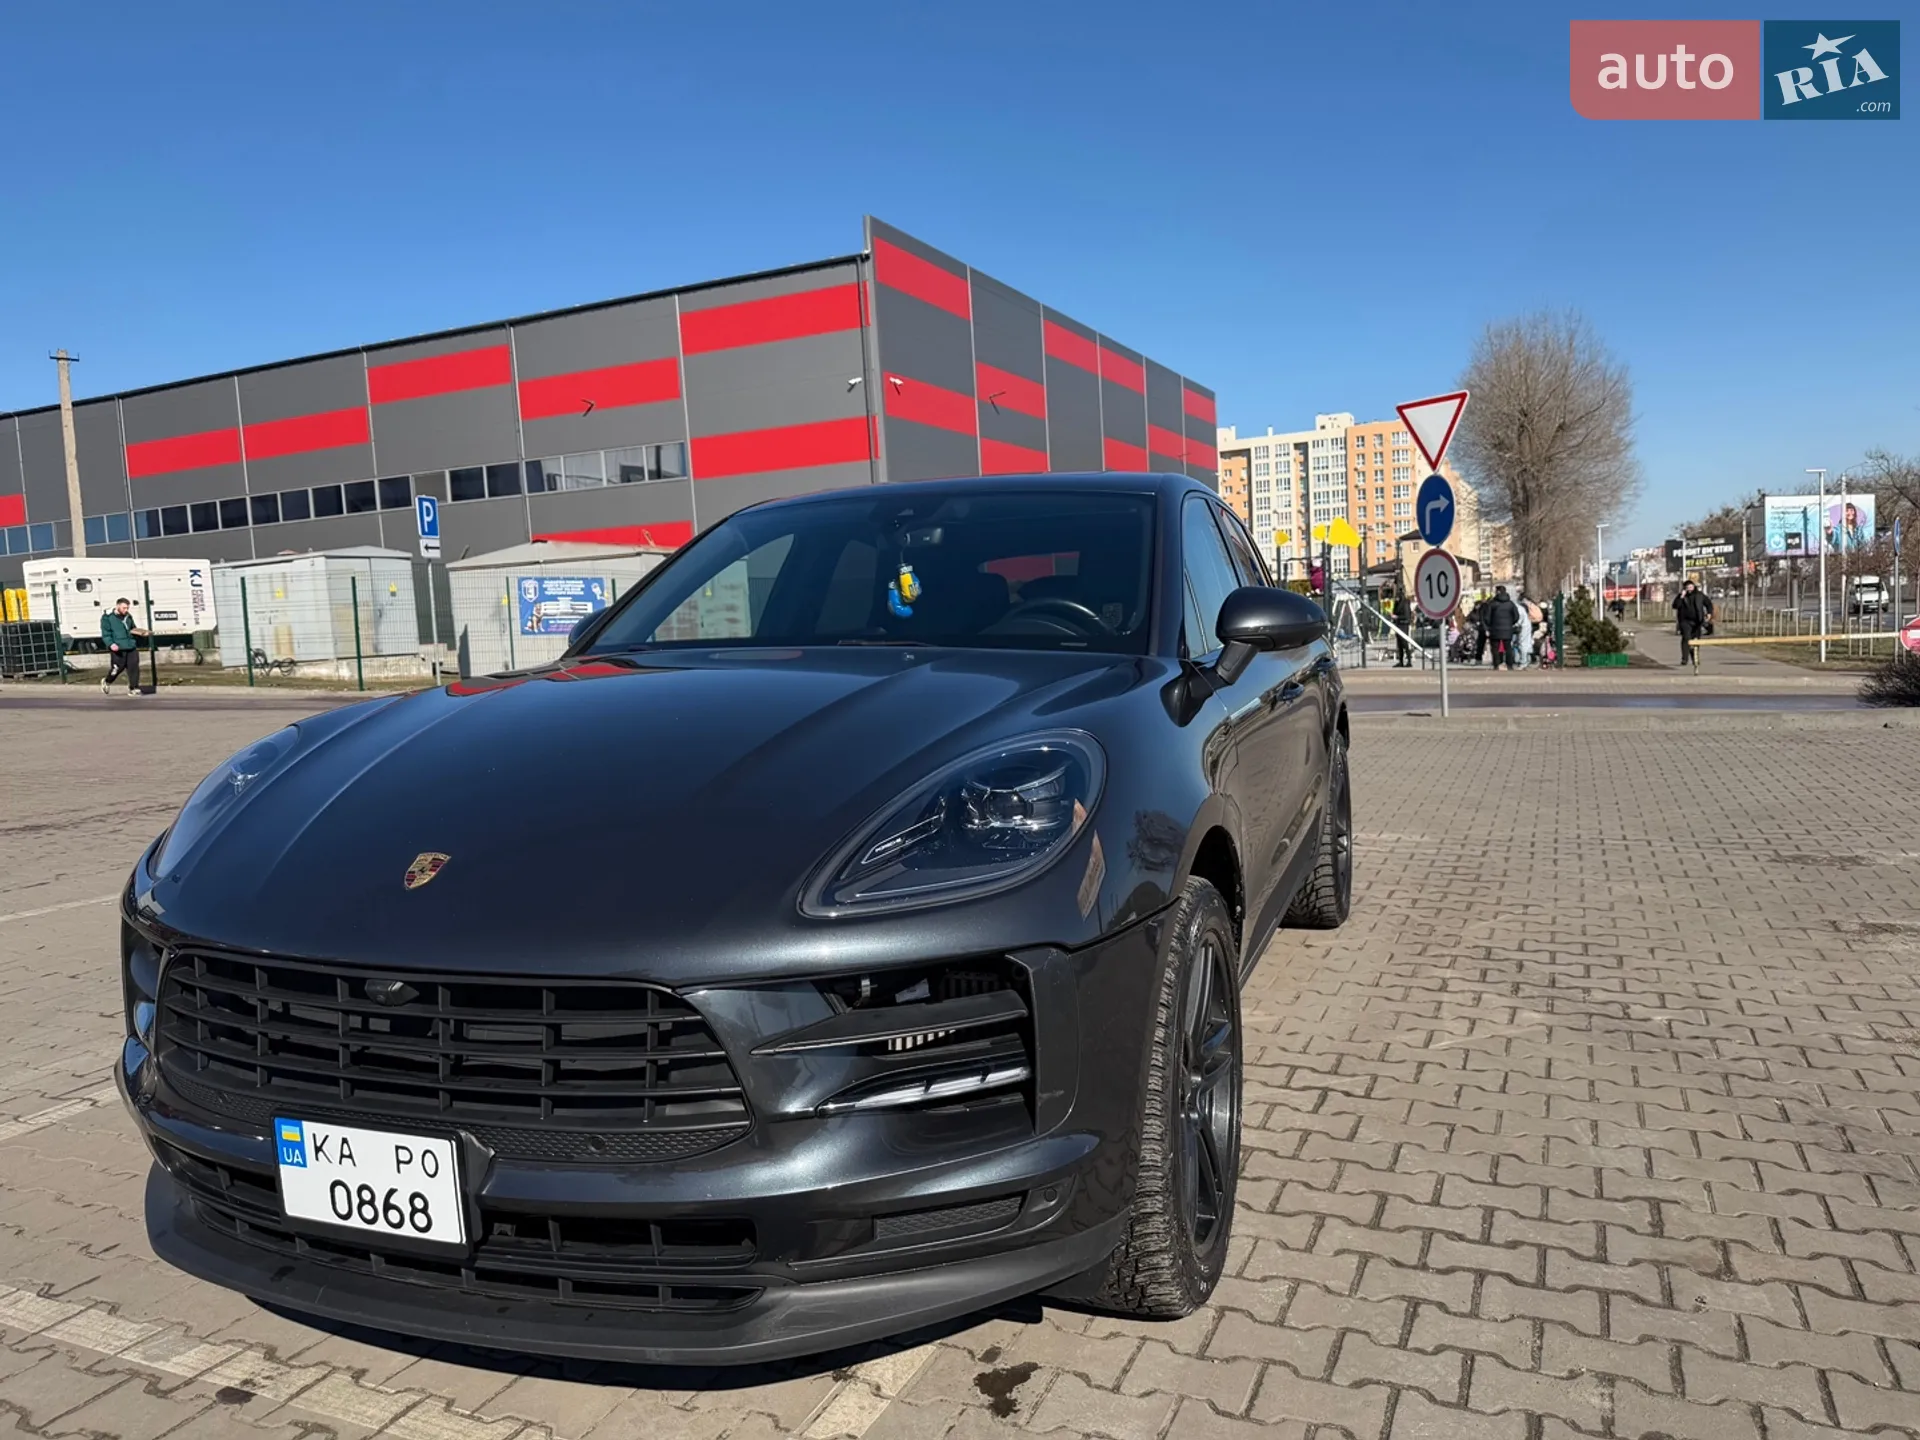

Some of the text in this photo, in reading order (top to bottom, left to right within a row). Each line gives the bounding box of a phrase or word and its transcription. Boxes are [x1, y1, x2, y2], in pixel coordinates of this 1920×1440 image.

[422, 501, 434, 532] P
[189, 569, 203, 587] KJ
[1425, 570, 1449, 600] 10
[283, 1147, 303, 1165] UA
[312, 1133, 439, 1179] KA PO
[329, 1179, 433, 1234] 0868
